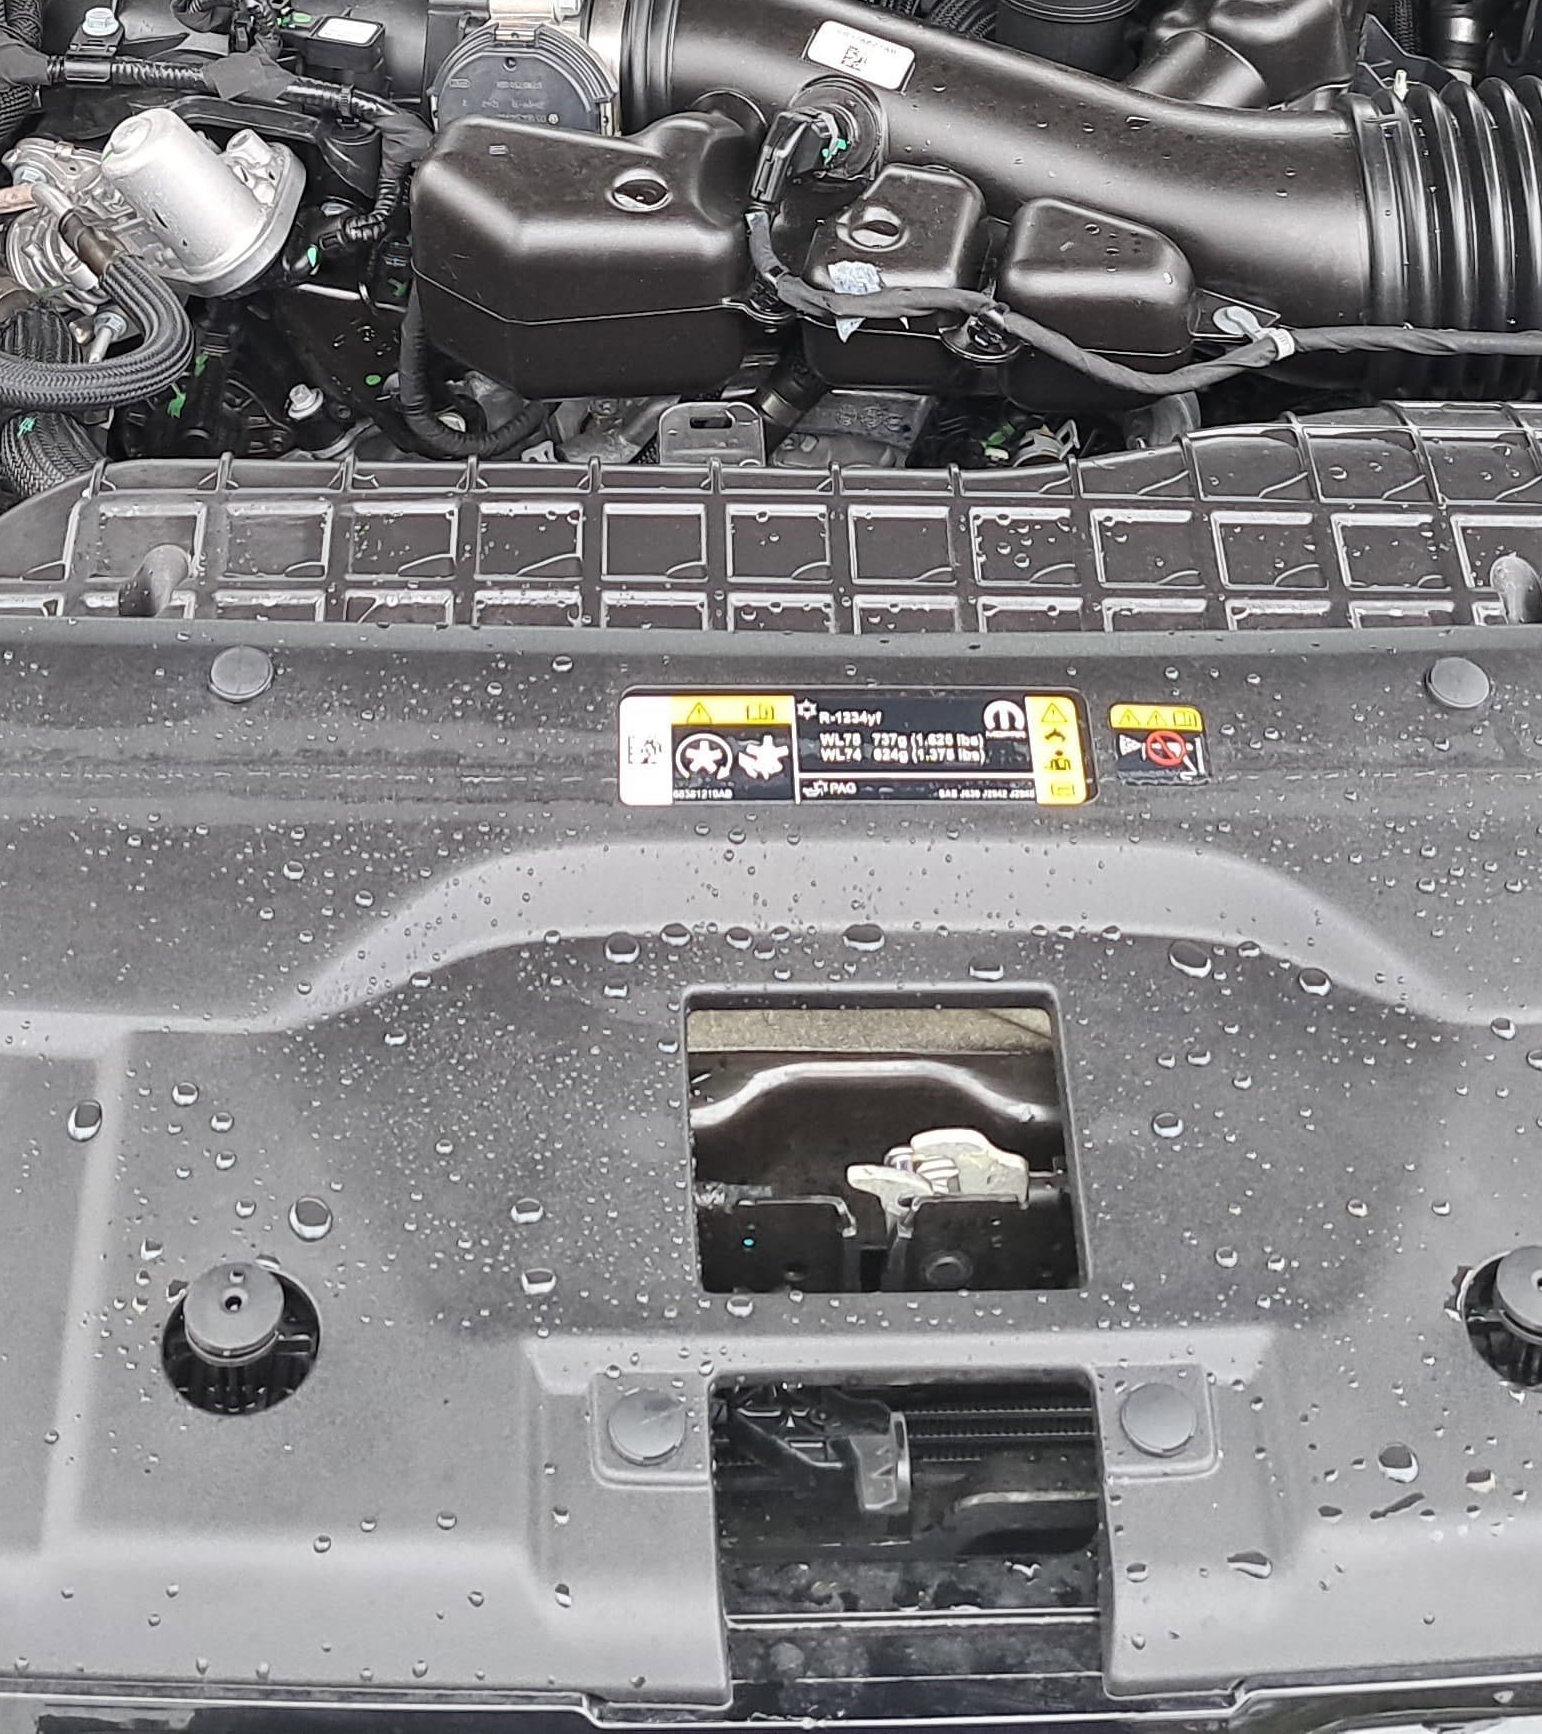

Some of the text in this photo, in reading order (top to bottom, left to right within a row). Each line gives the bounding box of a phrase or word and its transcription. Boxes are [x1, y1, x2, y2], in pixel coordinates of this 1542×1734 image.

[818, 711, 882, 727] R-1234yf
[871, 732, 908, 749] 737g
[956, 732, 986, 749] lbs)
[820, 747, 863, 762] WL74
[872, 748, 909, 764] 624g
[957, 747, 987, 764] lbs)
[829, 782, 858, 795] PAG
